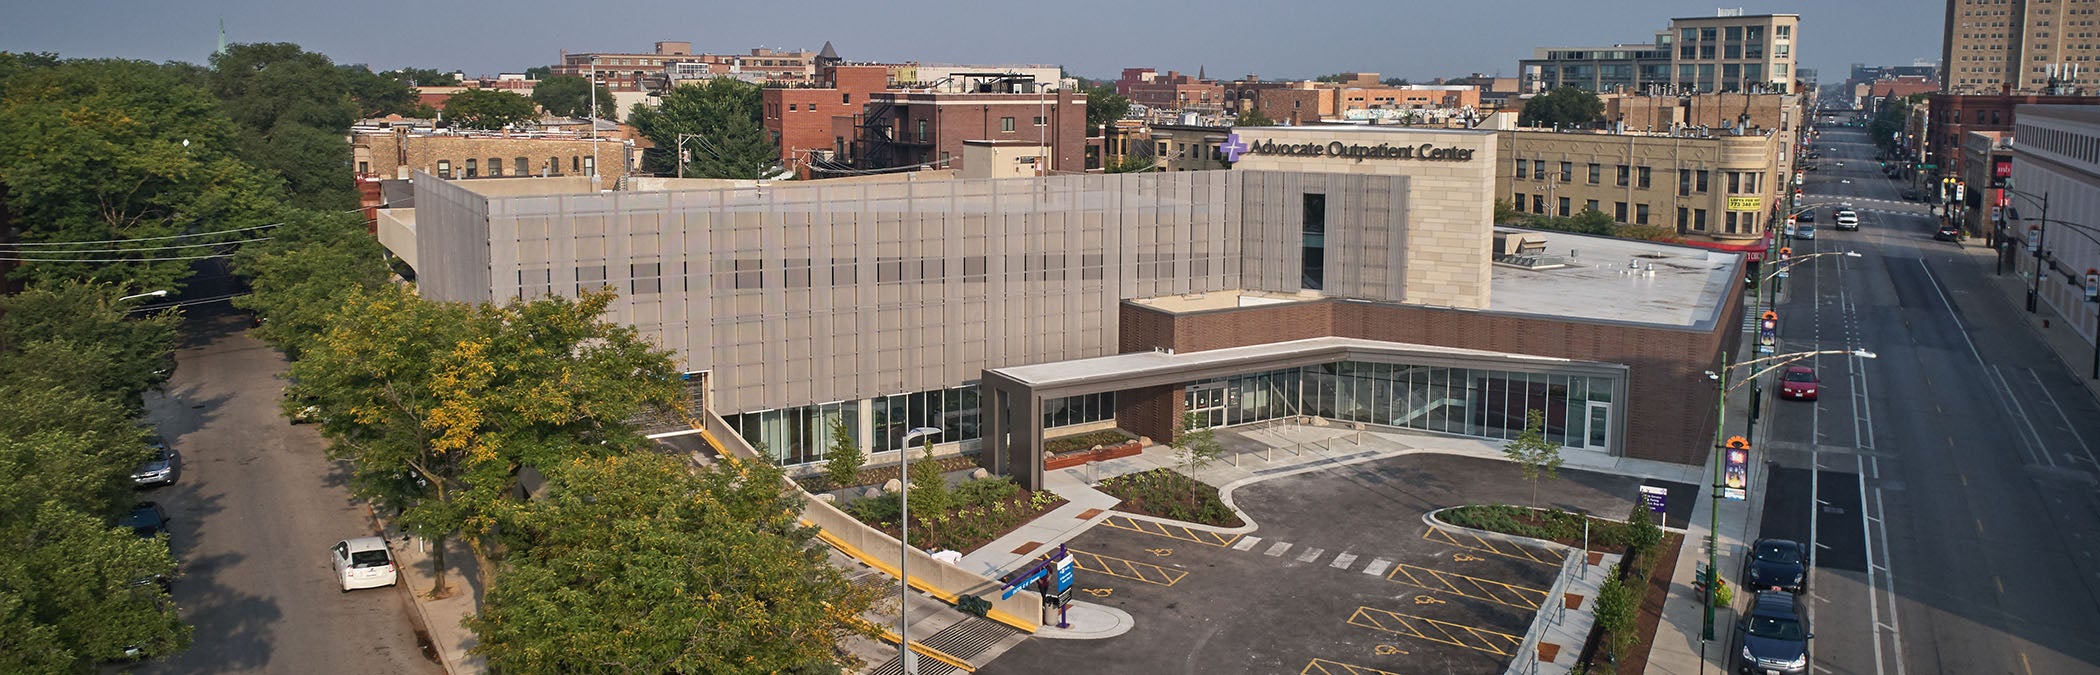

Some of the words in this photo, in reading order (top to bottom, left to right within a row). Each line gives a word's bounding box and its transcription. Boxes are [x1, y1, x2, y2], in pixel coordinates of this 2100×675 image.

[1250, 138, 1324, 156] Advocate
[1329, 141, 1414, 162] Outpatient
[1420, 143, 1475, 160] Center
